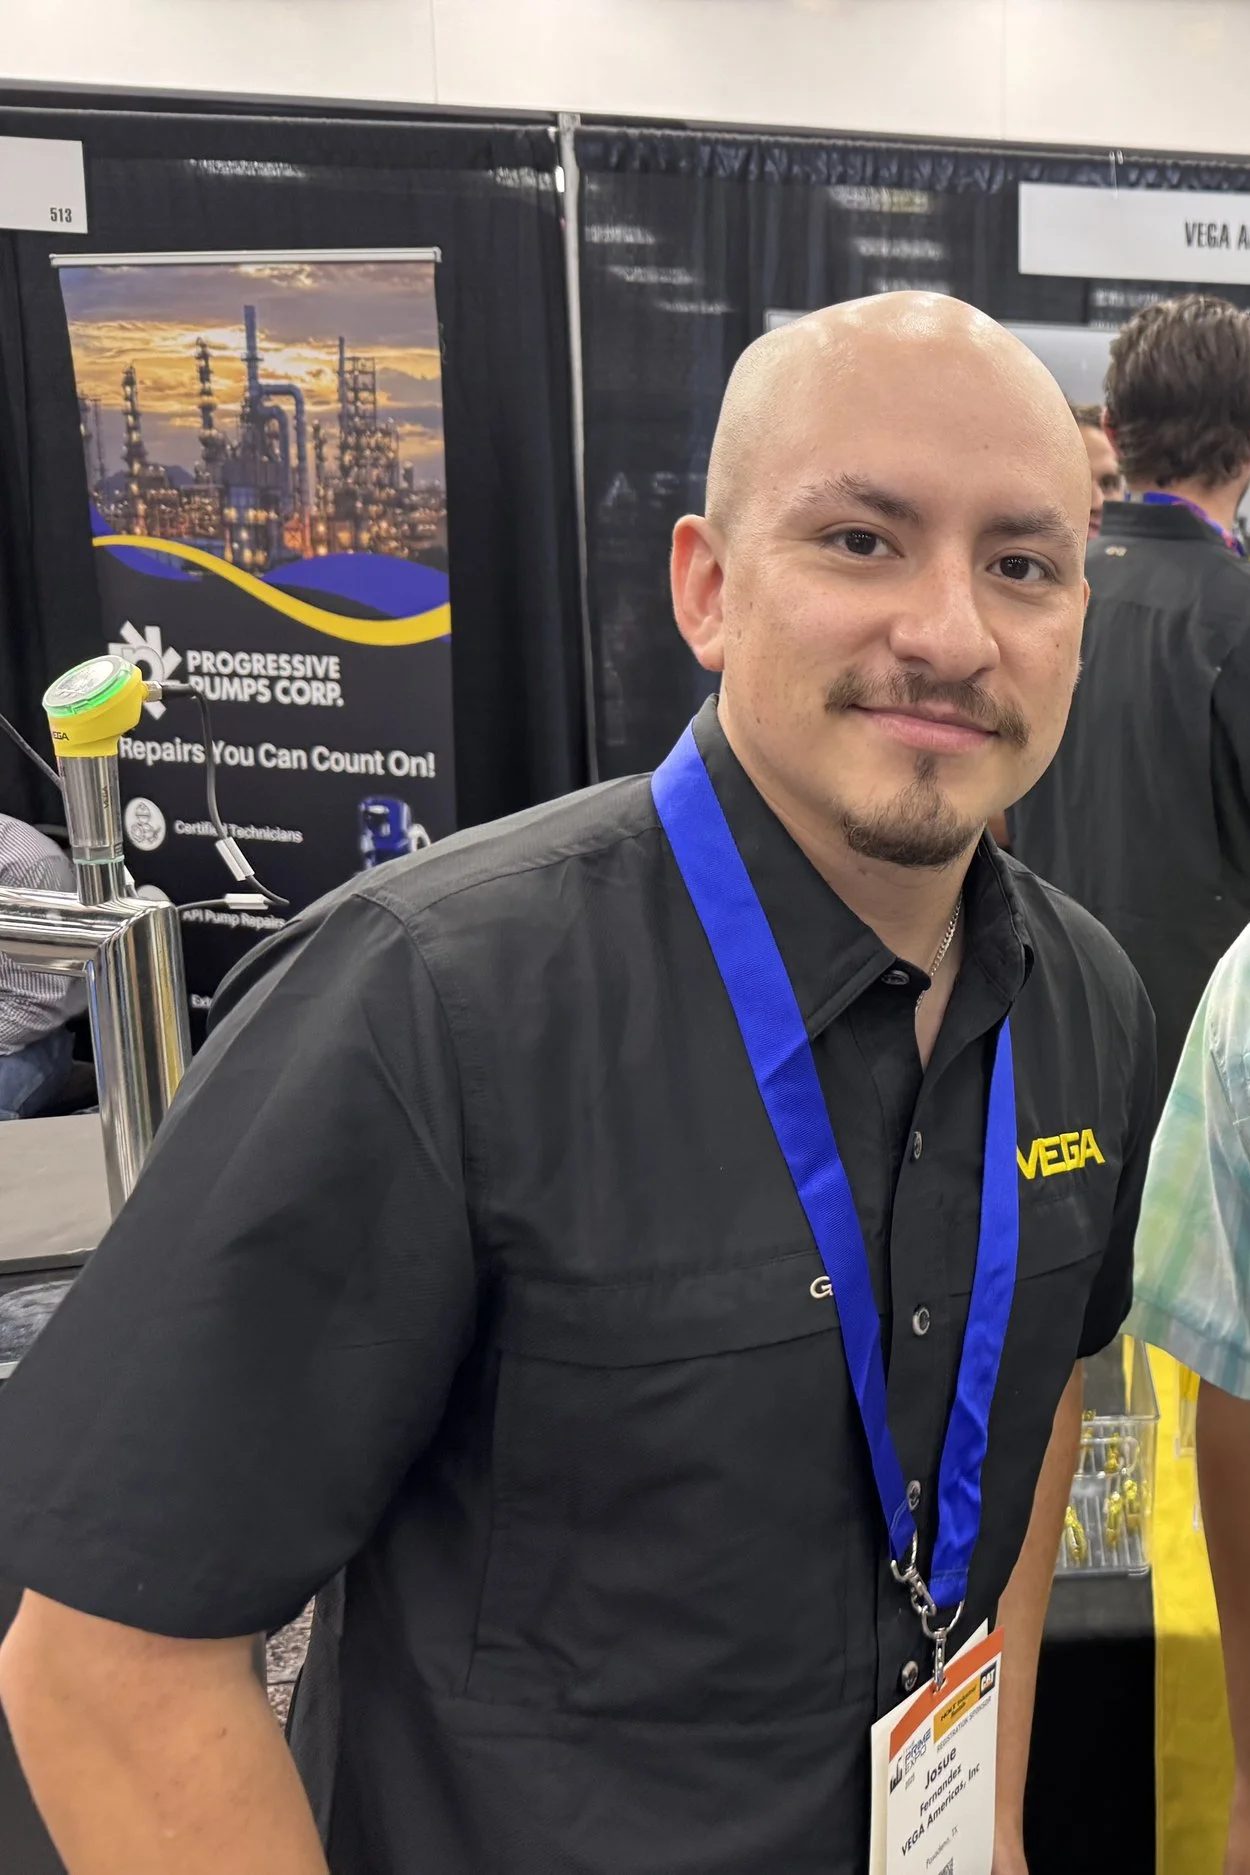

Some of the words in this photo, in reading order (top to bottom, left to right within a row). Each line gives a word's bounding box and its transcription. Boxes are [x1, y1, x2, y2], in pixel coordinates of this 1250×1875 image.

[50, 207, 72, 223] 513
[1184, 221, 1231, 249] VEGA
[186, 650, 341, 680] PROGRESSIVE
[188, 675, 271, 704] PUMPS
[274, 679, 344, 707] CORP.
[119, 737, 206, 765] Repairs
[211, 741, 255, 768] You
[259, 744, 308, 771] Can
[311, 746, 385, 776] Count
[388, 750, 436, 778] On!
[229, 824, 304, 844] Technicians
[183, 908, 204, 922] API
[204, 909, 241, 929] Pump
[241, 912, 286, 931] Repairs
[1016, 1128, 1106, 1180] VEGA
[905, 1728, 931, 1760] PRIME
[905, 1744, 927, 1775] EXPO
[925, 1747, 957, 1789] Josue
[920, 1764, 962, 1817] Fernandez
[901, 1823, 925, 1856] VEGA
[927, 1780, 966, 1829] Americas,
[968, 1762, 980, 1782] Inc
